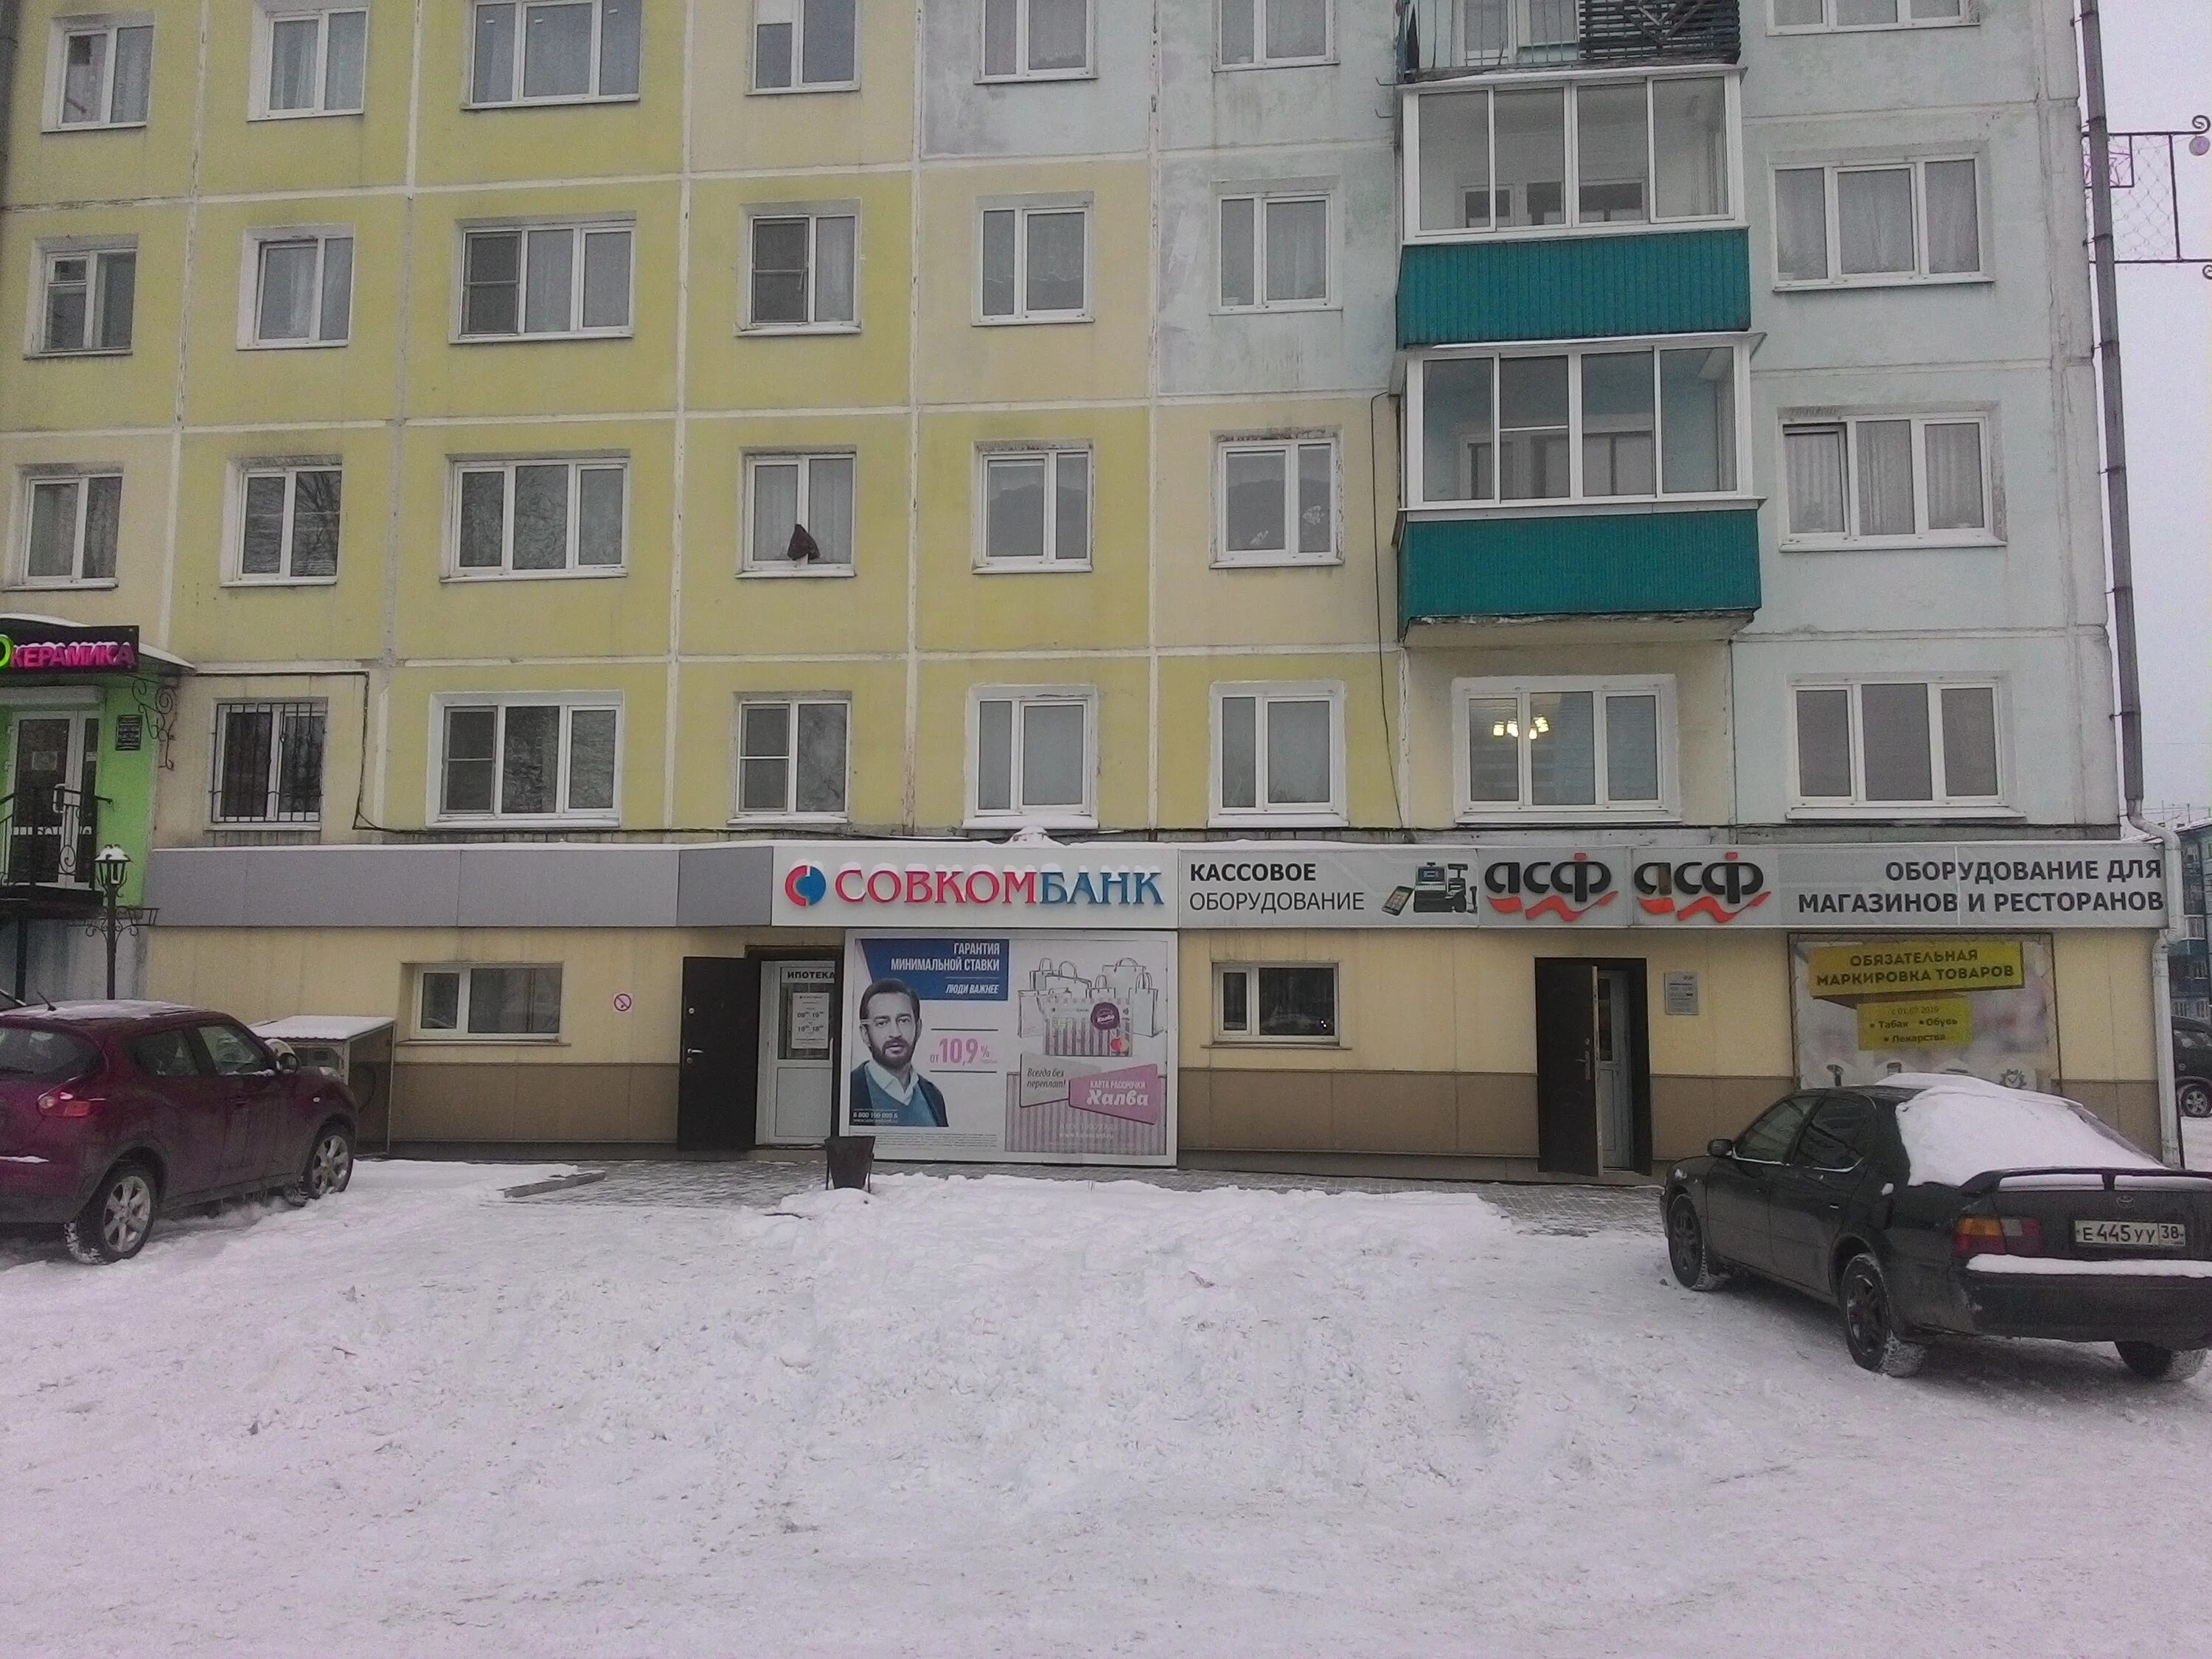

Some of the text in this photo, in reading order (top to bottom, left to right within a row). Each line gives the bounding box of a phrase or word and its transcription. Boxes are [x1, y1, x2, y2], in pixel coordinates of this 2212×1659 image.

[11, 644, 136, 667] КЕРАМИКА
[1190, 863, 1316, 881] КАССОВОЕ
[1885, 860, 2161, 885] ОБОРУДОВАНИЕ ДЛЯ
[835, 869, 1164, 904] СОВКОМБАНК
[1189, 891, 1365, 914] ОБОРУДОВАНИЕ
[1798, 891, 2164, 913] МАГАЗИНОВ И РЕСТОРАНОВ
[953, 942, 1001, 956] ГАРАНТИЯ
[891, 957, 1000, 972] МИНИМАЛЬНОЙ СТАВКИ
[1850, 949, 1978, 967] ОБЯЗАТЕЛЬНАЯ
[787, 971, 835, 979] ИПОТЕКА
[1816, 965, 2014, 986] МАРКИРОВКА ТОВАРОВ
[945, 984, 999, 995] ЛЮДИ ВАЖНЕЕ
[1878, 1018, 1958, 1029] Табак Обувь
[1892, 1034, 1946, 1043] Лекарства
[939, 1038, 978, 1066] 10,9
[1027, 1068, 1064, 1078] Всегда без
[1027, 1079, 1065, 1089] переплат!
[1090, 1080, 1146, 1090] КАРТА РАССРОЧКИ
[1086, 1090, 1149, 1106] Халва
